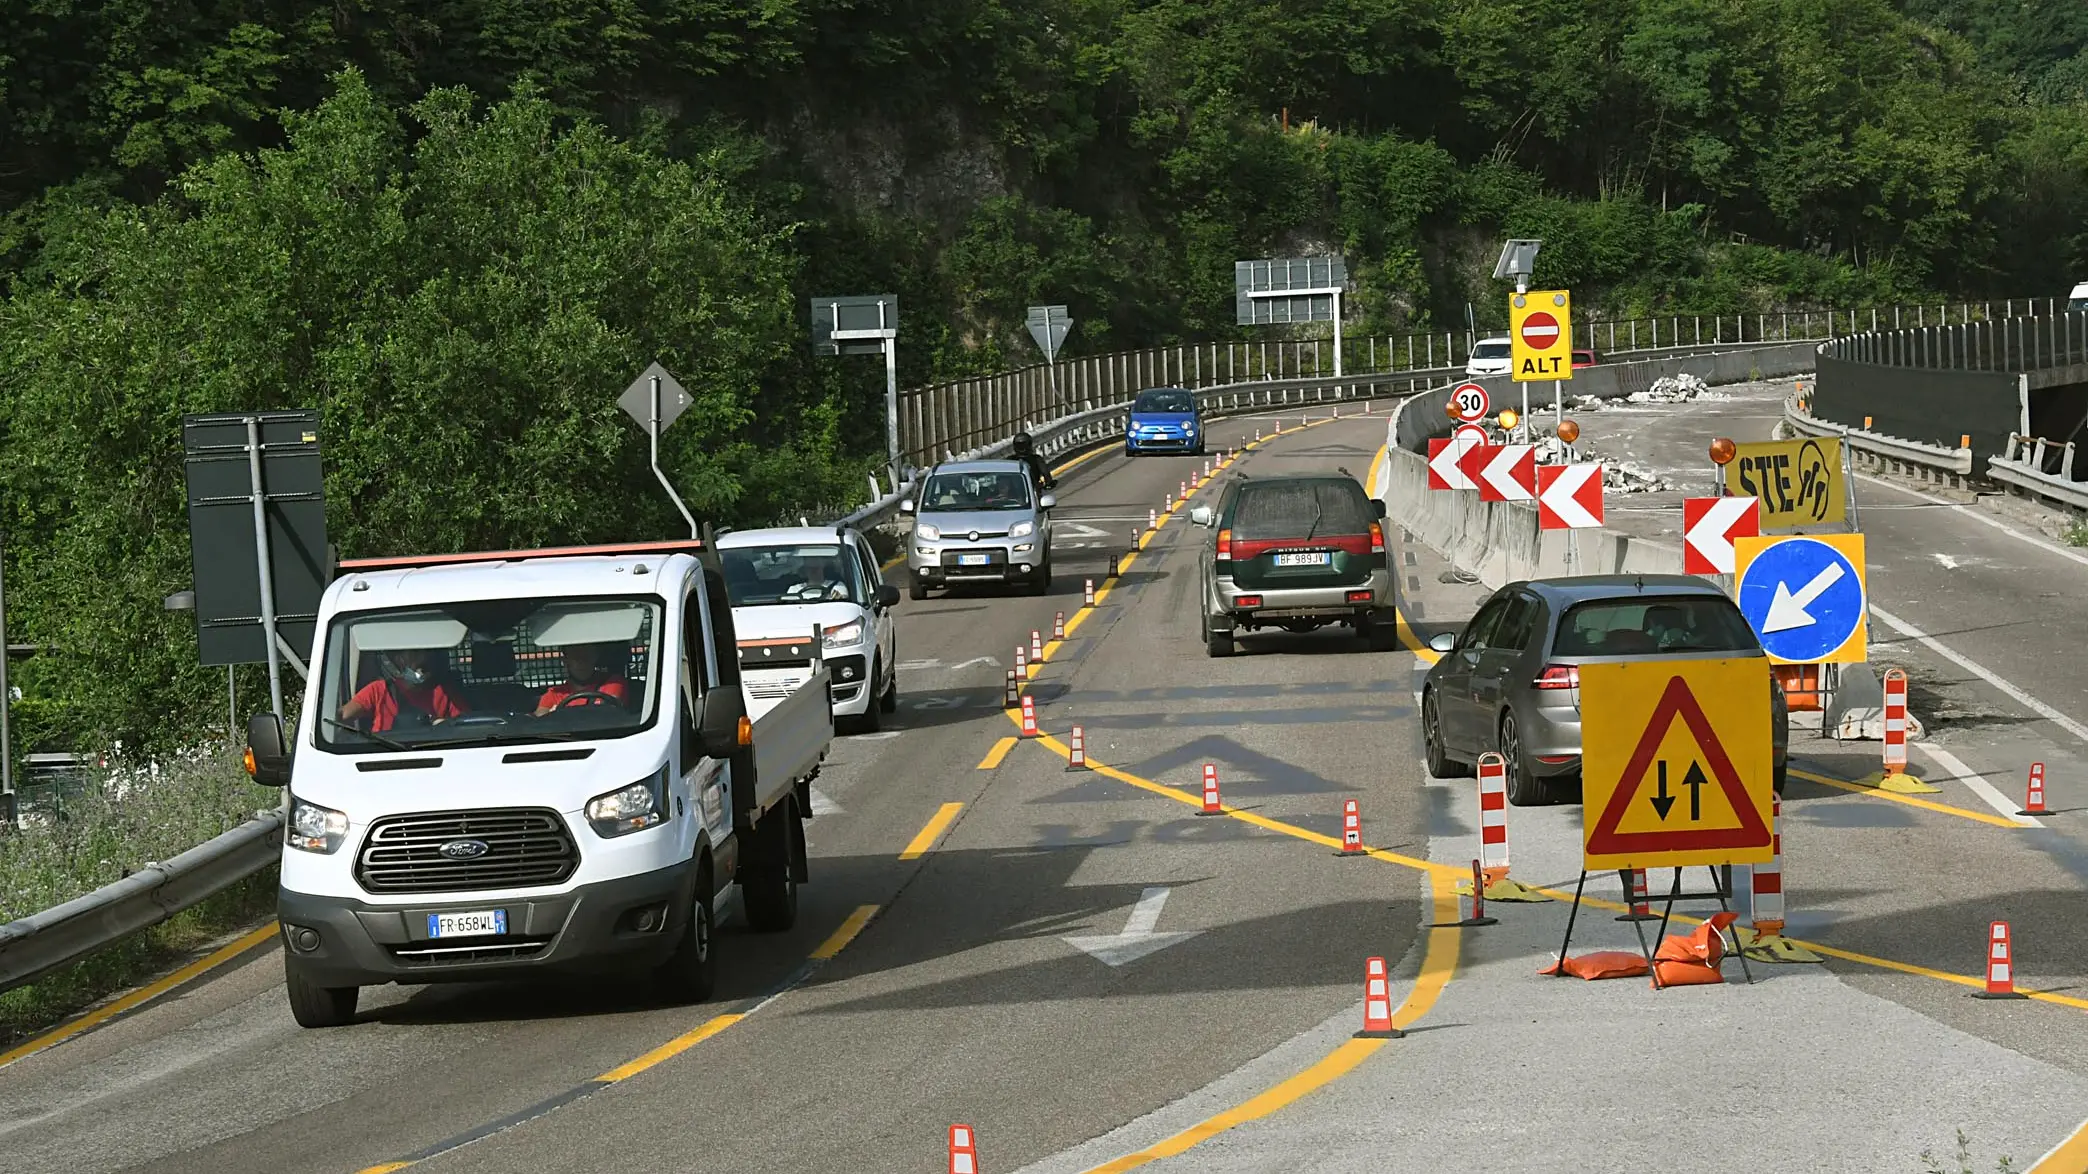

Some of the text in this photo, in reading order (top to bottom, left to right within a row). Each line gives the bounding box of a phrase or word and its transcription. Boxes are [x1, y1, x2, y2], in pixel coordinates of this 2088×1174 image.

[1522, 357, 1562, 374] ALT
[1460, 394, 1481, 411] 30
[1280, 554, 1291, 564] BF
[450, 844, 477, 855] Ford
[440, 918, 454, 933] FR
[458, 916, 494, 932] 658WL
